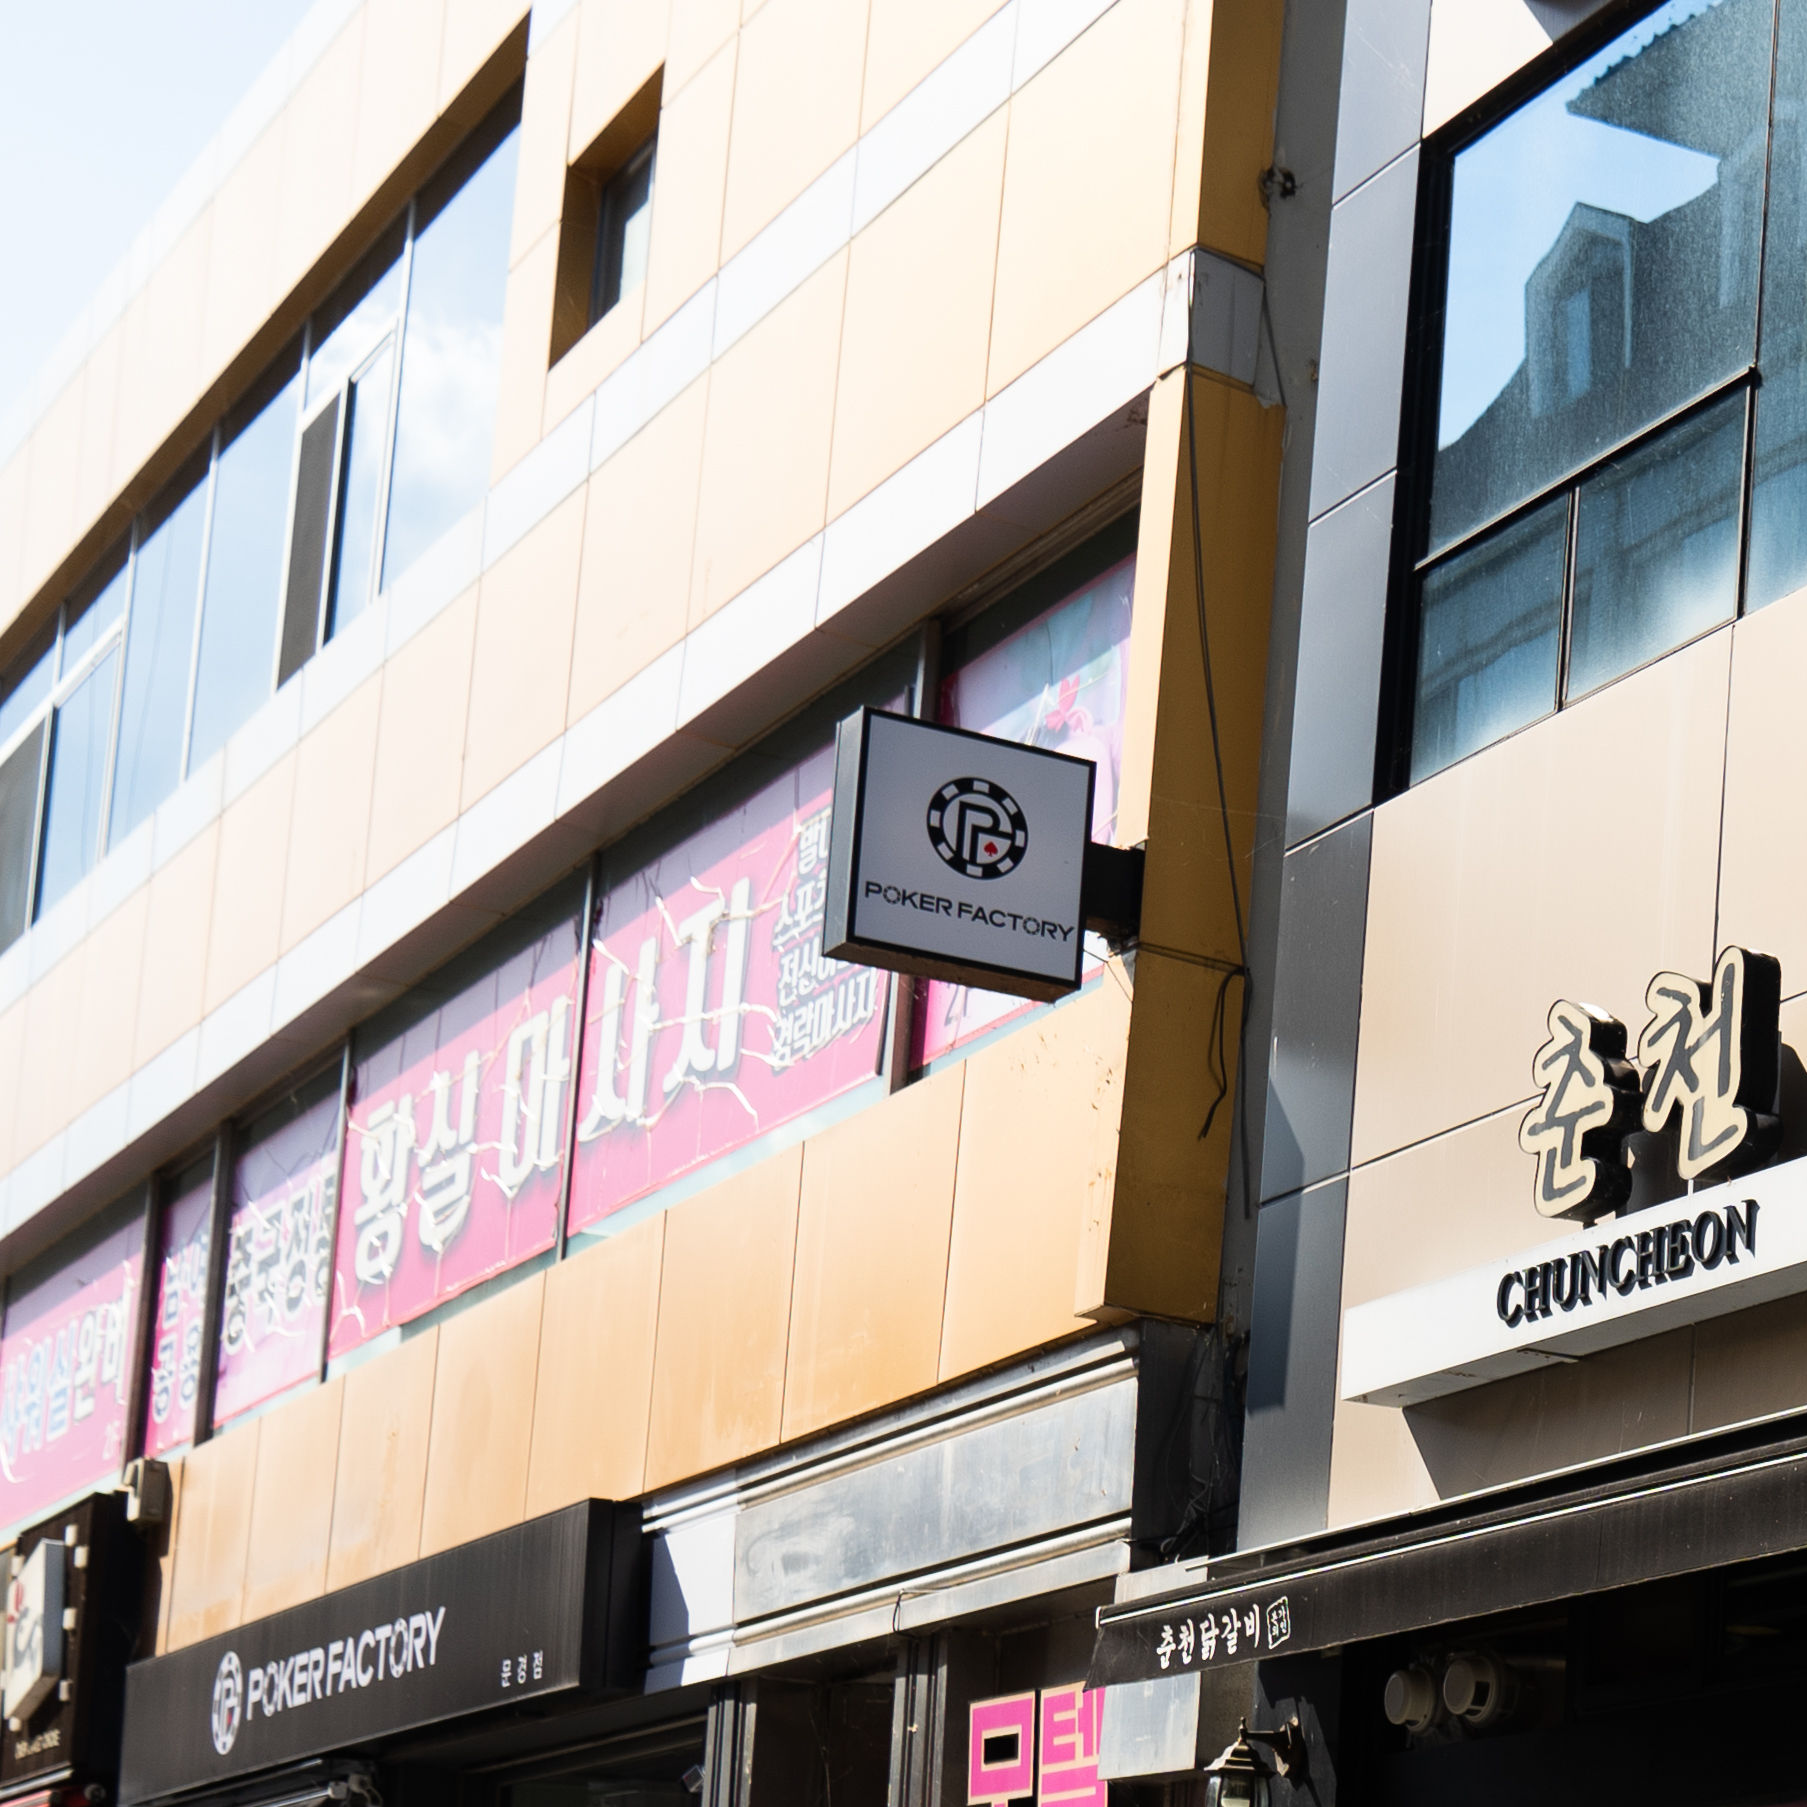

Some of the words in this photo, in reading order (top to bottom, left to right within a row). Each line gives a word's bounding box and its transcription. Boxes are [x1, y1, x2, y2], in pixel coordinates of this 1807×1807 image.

[865, 880, 952, 917] POKER
[958, 901, 1074, 942] FACTORY
[1519, 945, 1747, 1218] 춘천
[1497, 1200, 1760, 1328] CHUNCHEON
[246, 1646, 325, 1721] POKER
[327, 1606, 446, 1696] FACTORY
[1156, 1603, 1260, 1670] 춘천닭갈비
